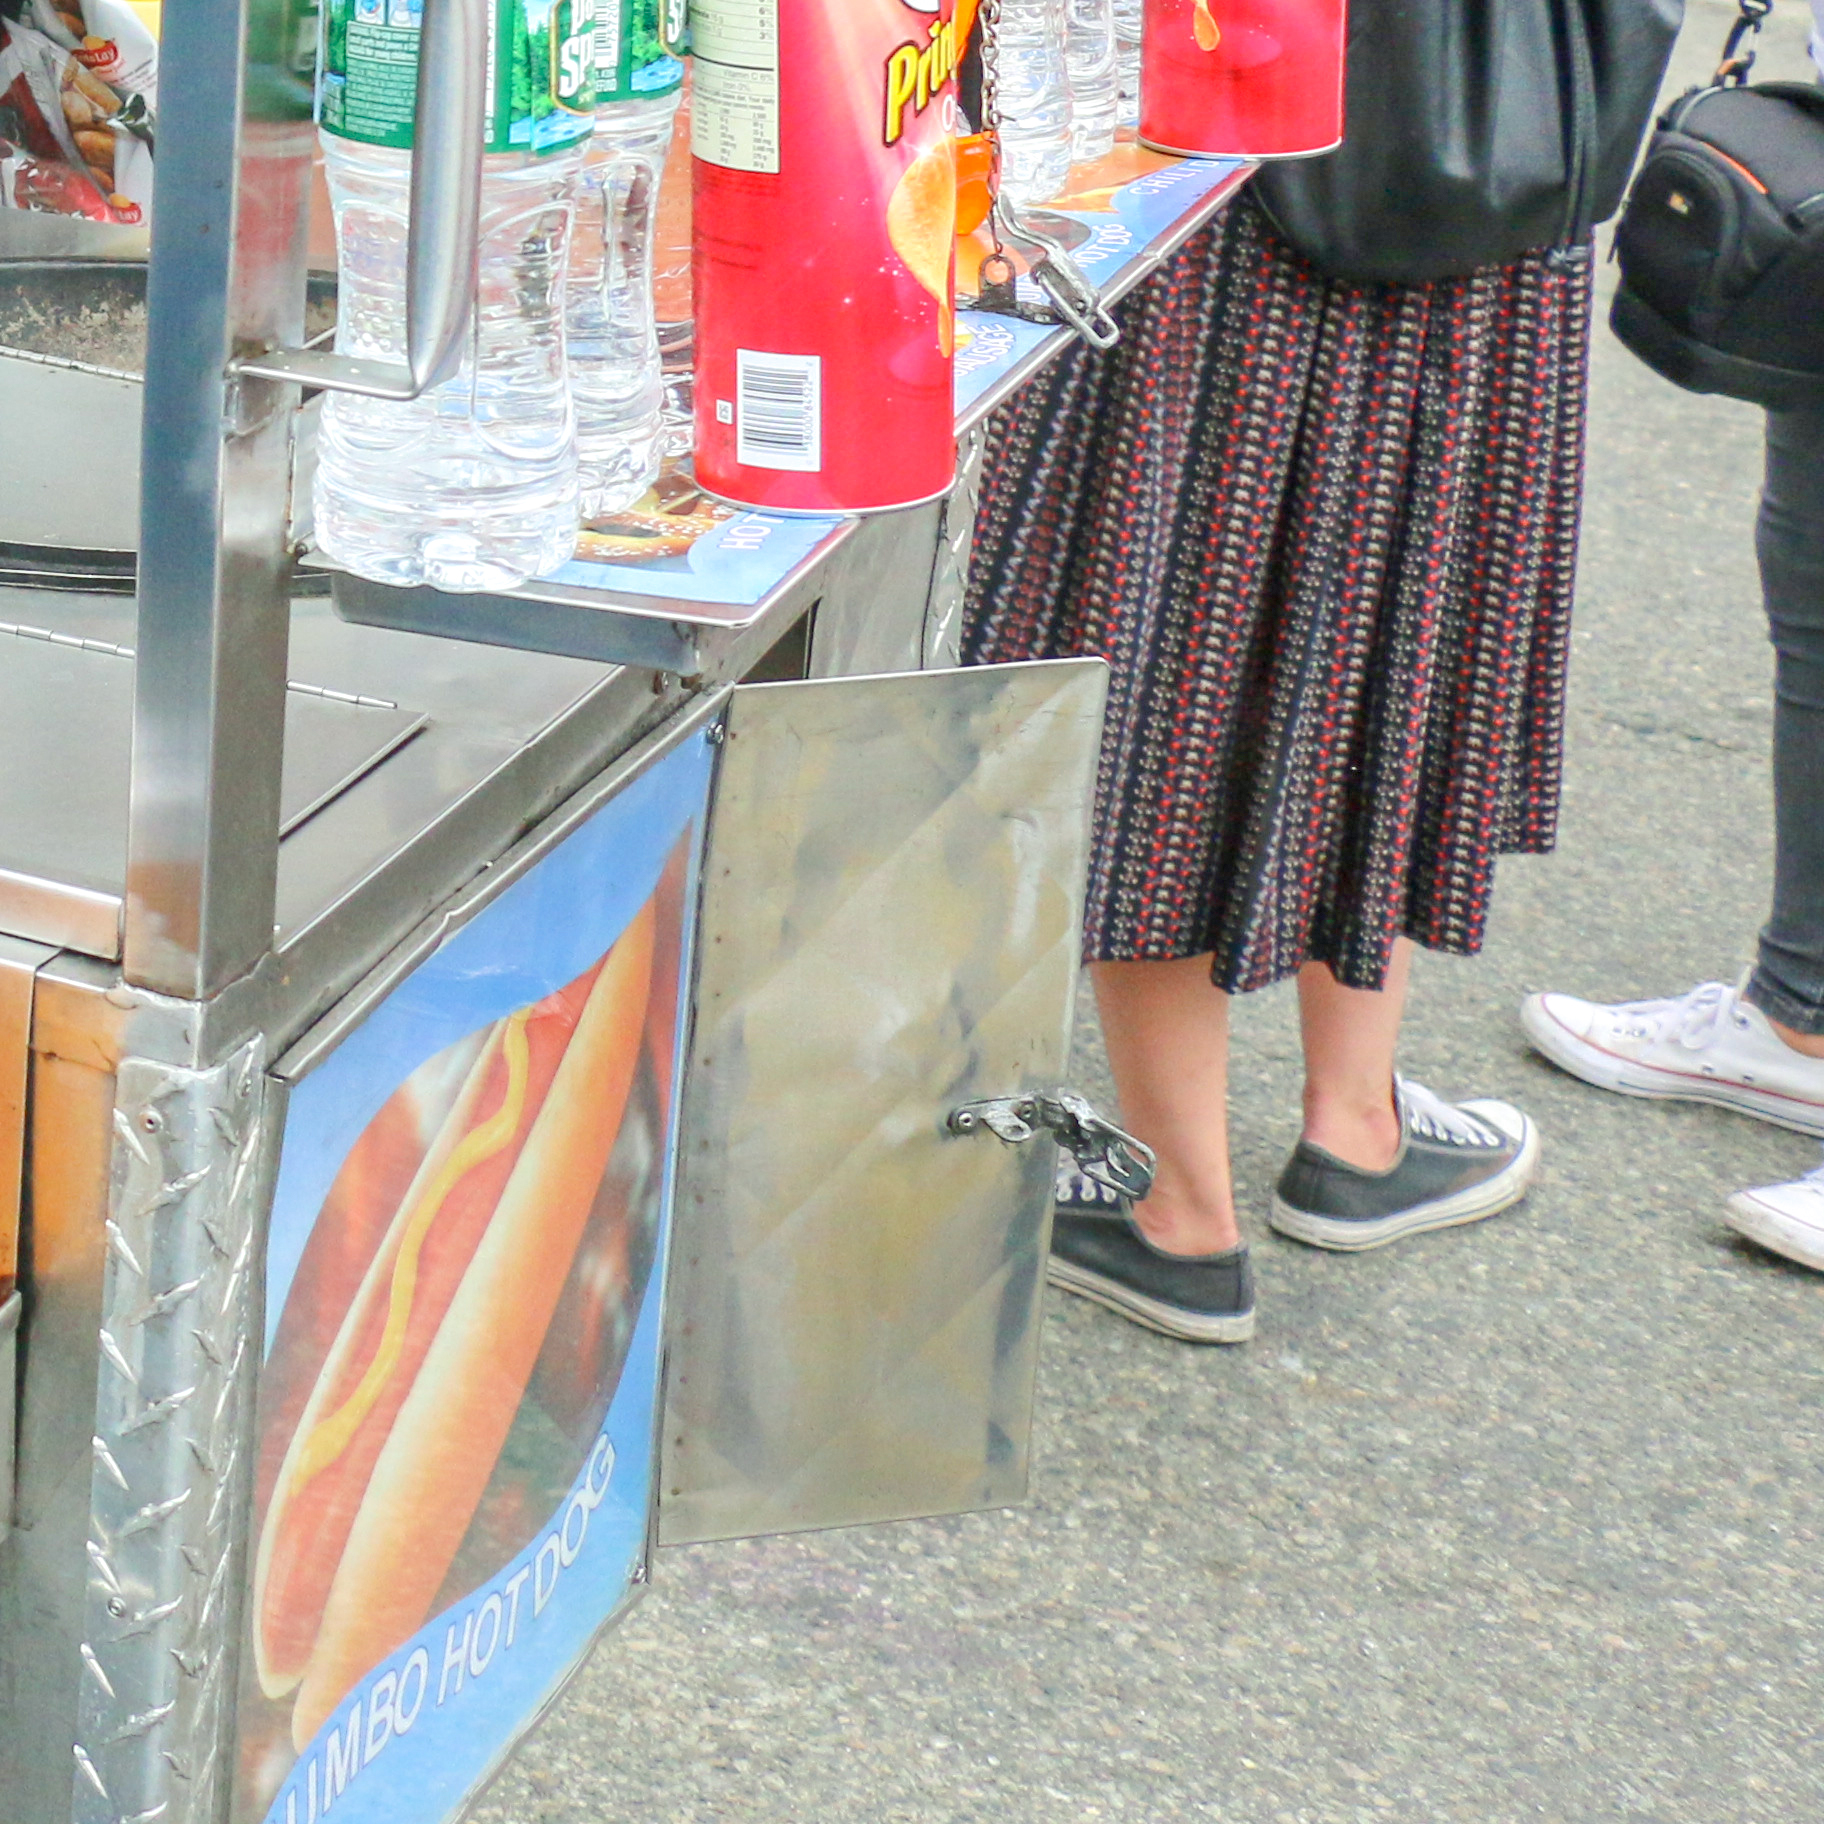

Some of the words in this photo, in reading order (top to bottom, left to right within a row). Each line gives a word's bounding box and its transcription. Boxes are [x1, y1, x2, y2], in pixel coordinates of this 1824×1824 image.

[883, 19, 956, 147] Prin
[1129, 166, 1204, 194] CHILI
[1092, 223, 1133, 245] DOG
[719, 513, 785, 550] HOT
[284, 1647, 429, 1824] UMBO
[436, 1564, 531, 1706] HOT
[533, 1430, 617, 1619] DOG
